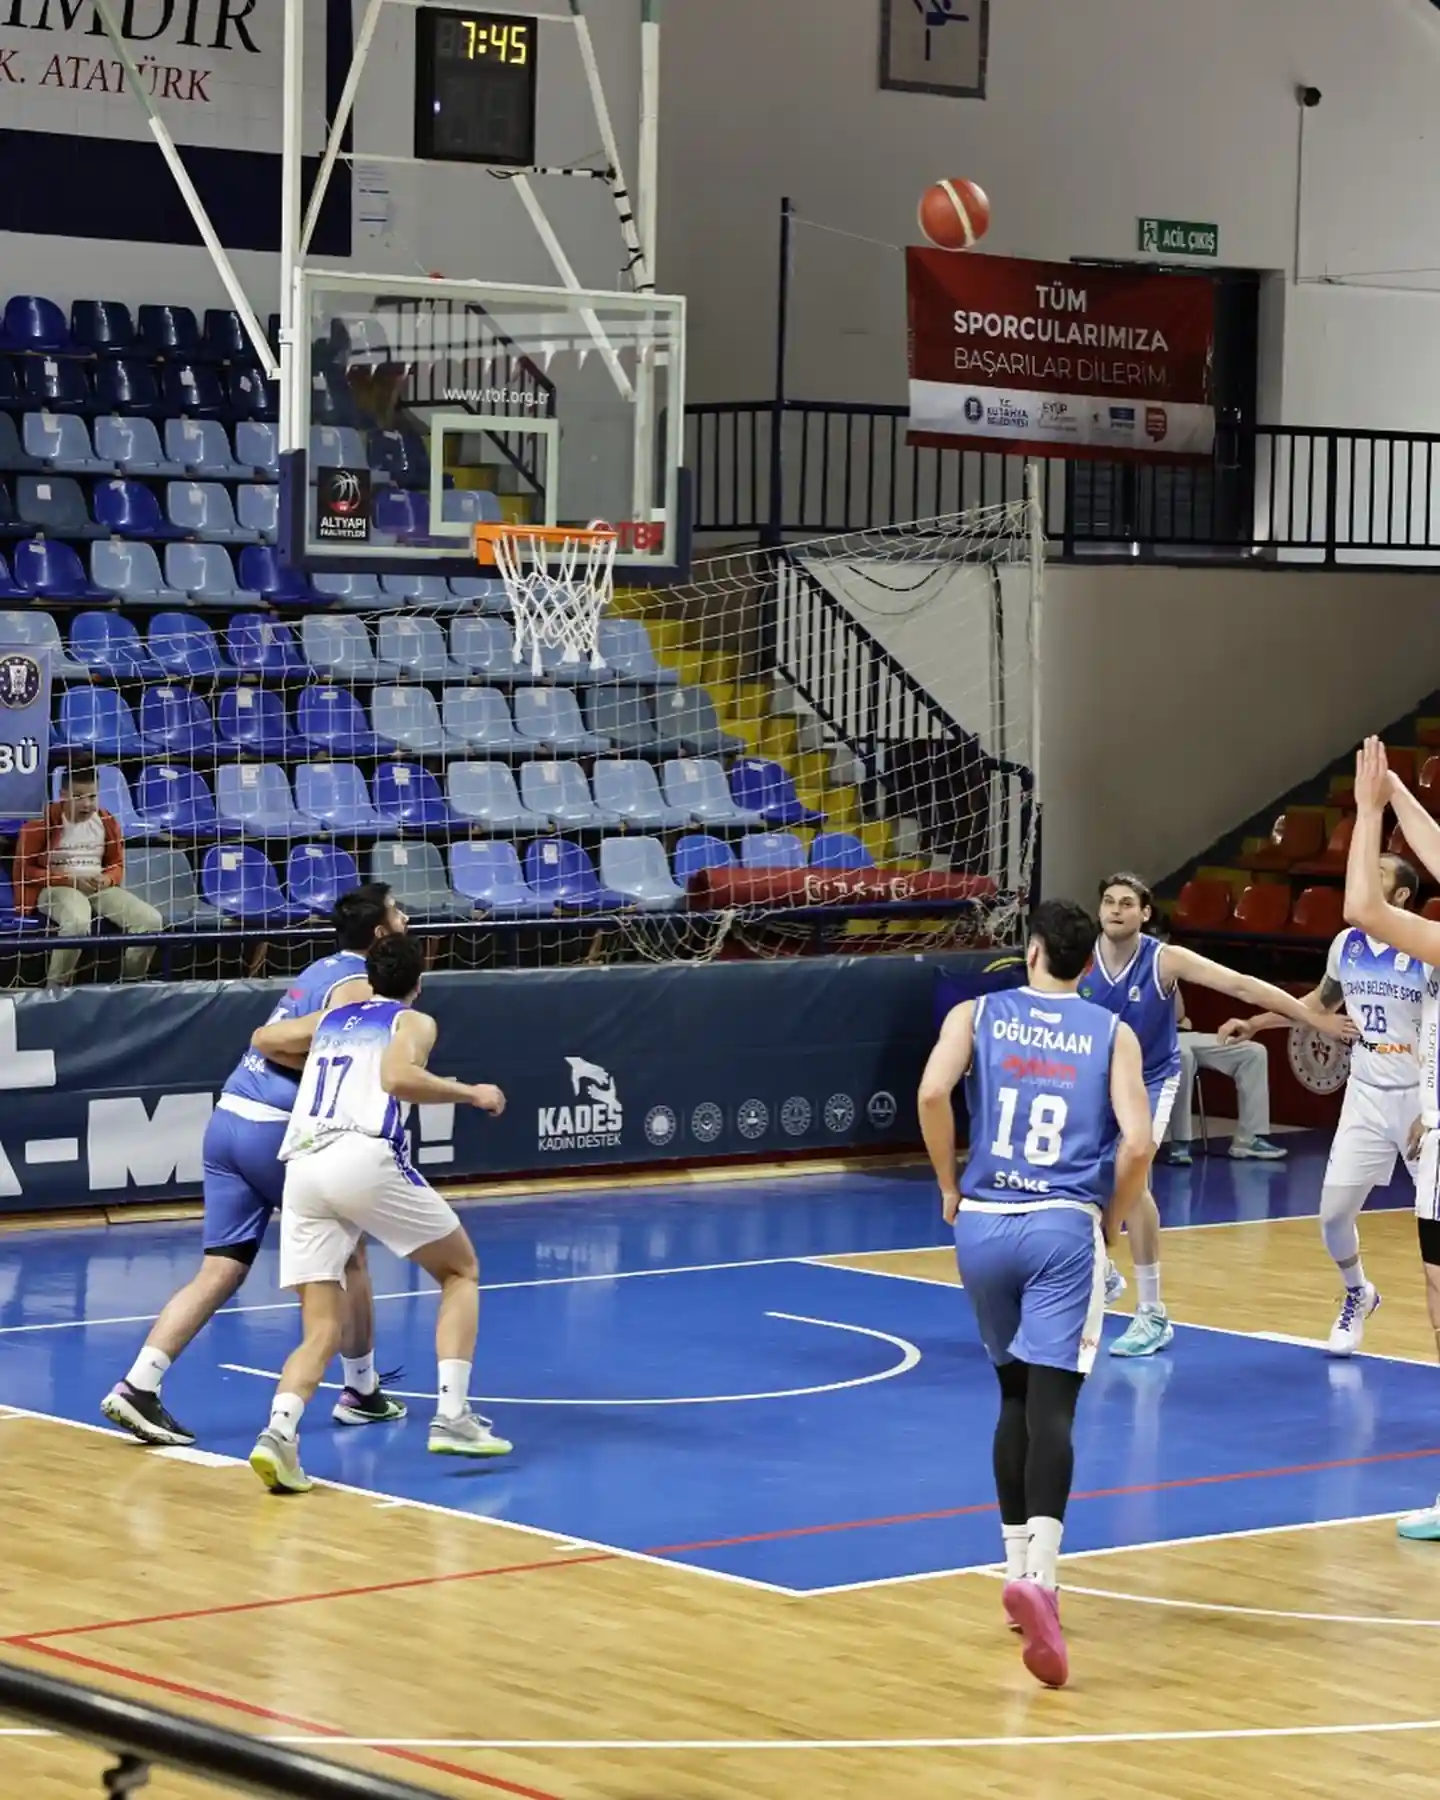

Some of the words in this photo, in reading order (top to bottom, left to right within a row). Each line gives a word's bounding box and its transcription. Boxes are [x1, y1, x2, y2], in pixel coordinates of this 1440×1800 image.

[461, 21, 527, 64] 7:45
[38, 53, 213, 103] ATATÜRK
[1035, 281, 1088, 313] TÜM
[953, 310, 1169, 352] SPORCULARIMIZA
[953, 347, 1073, 378] BAŞARILAR
[320, 516, 366, 530] ALTYAPI
[1361, 1004, 1388, 1034] 26
[993, 1018, 1093, 1056] OĞUZKAAN
[309, 1055, 354, 1119] 17
[538, 1103, 624, 1137] KADES
[991, 1088, 1069, 1167] 18
[538, 1136, 576, 1152] KADIN
[577, 1133, 622, 1149] DESTEK
[993, 1170, 1051, 1194] SÖKE
